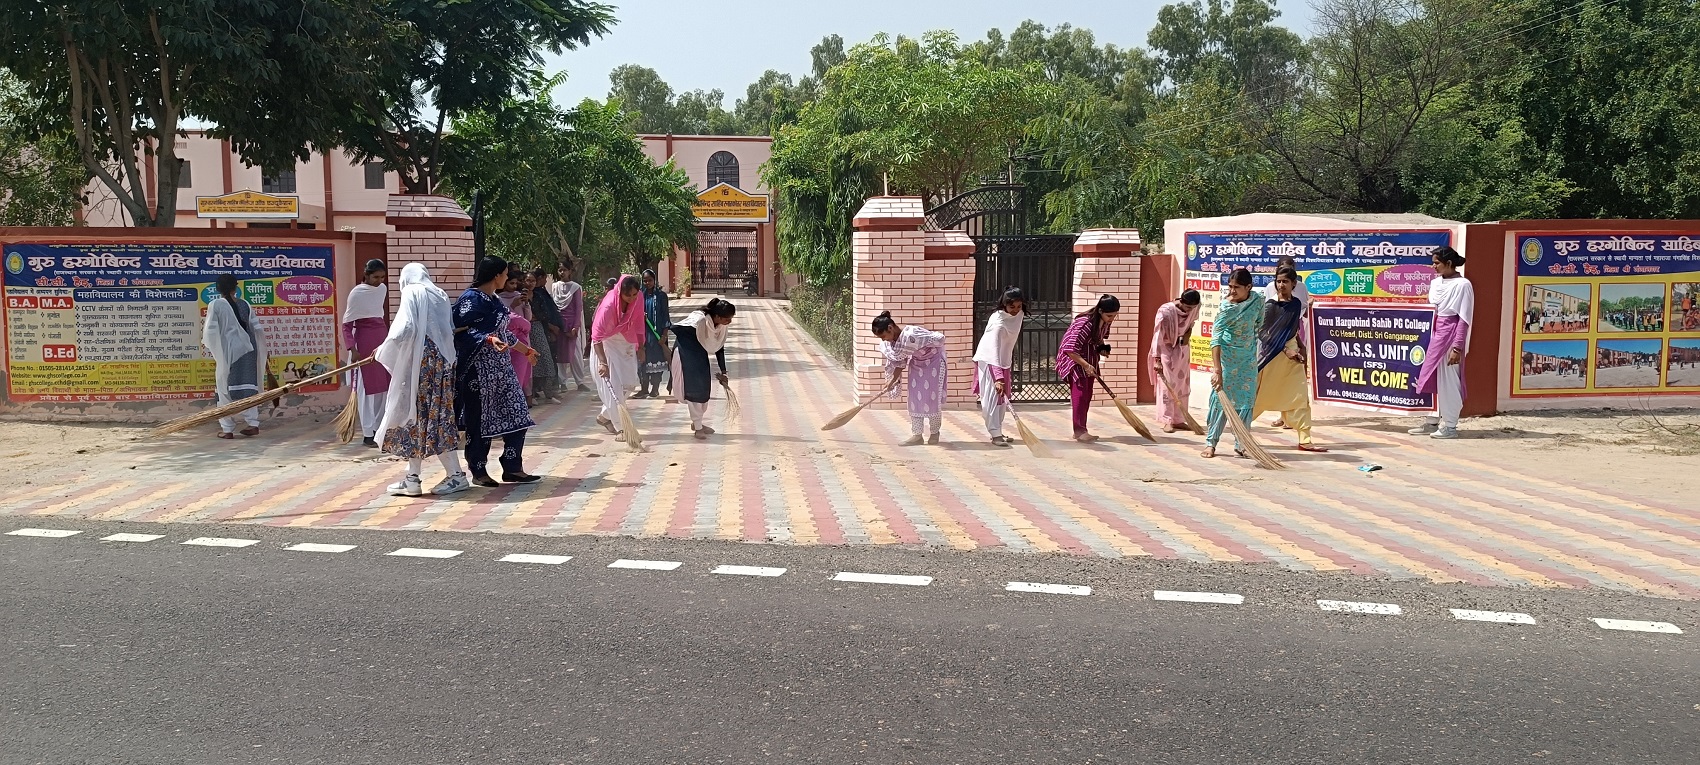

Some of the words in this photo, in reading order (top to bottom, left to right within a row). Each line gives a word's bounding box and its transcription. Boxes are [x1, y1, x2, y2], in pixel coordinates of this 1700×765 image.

[1198, 245, 1213, 258] गुरु
[1216, 241, 1263, 256] हरगोबिन्द
[1267, 241, 1306, 257] साहिब
[1312, 242, 1346, 256] पीजी
[1553, 240, 1580, 256] गुरु
[1586, 236, 1655, 252] हरगोबिन्द
[28, 257, 55, 272] गुरु
[62, 253, 141, 269] हरगोबिन्द
[149, 253, 199, 269] साहिब
[206, 254, 243, 268] पीजी
[250, 255, 325, 269] महाविद्यालय
[1310, 272, 1333, 281] प्रवेश
[1345, 272, 1372, 283] सीमित
[246, 283, 272, 293] सीमित
[1188, 281, 1199, 290] B.A.
[1204, 282, 1217, 291] M.A.
[1348, 283, 1366, 293] सीटें
[77, 290, 124, 299] महाविद्यालय
[129, 290, 140, 299] की
[250, 294, 267, 304] सीटें
[9, 299, 35, 307] B.A.
[42, 299, 71, 308] M.A.
[1318, 316, 1333, 326] Guru
[1335, 316, 1370, 329] Hargobind
[1372, 317, 1391, 329] Sahib
[1394, 318, 1403, 329] PG
[1404, 319, 1430, 332] College
[1375, 331, 1383, 339] Sri
[1384, 332, 1419, 342] Ganganagar
[44, 348, 75, 359] B.Ed
[1341, 342, 1375, 359] N.S.S.
[1379, 344, 1409, 361] UNIT
[1363, 360, 1386, 370] (SFS)
[1339, 367, 1366, 385] WEL
[1370, 370, 1409, 390] COME
[1326, 389, 1341, 397] Mob.
